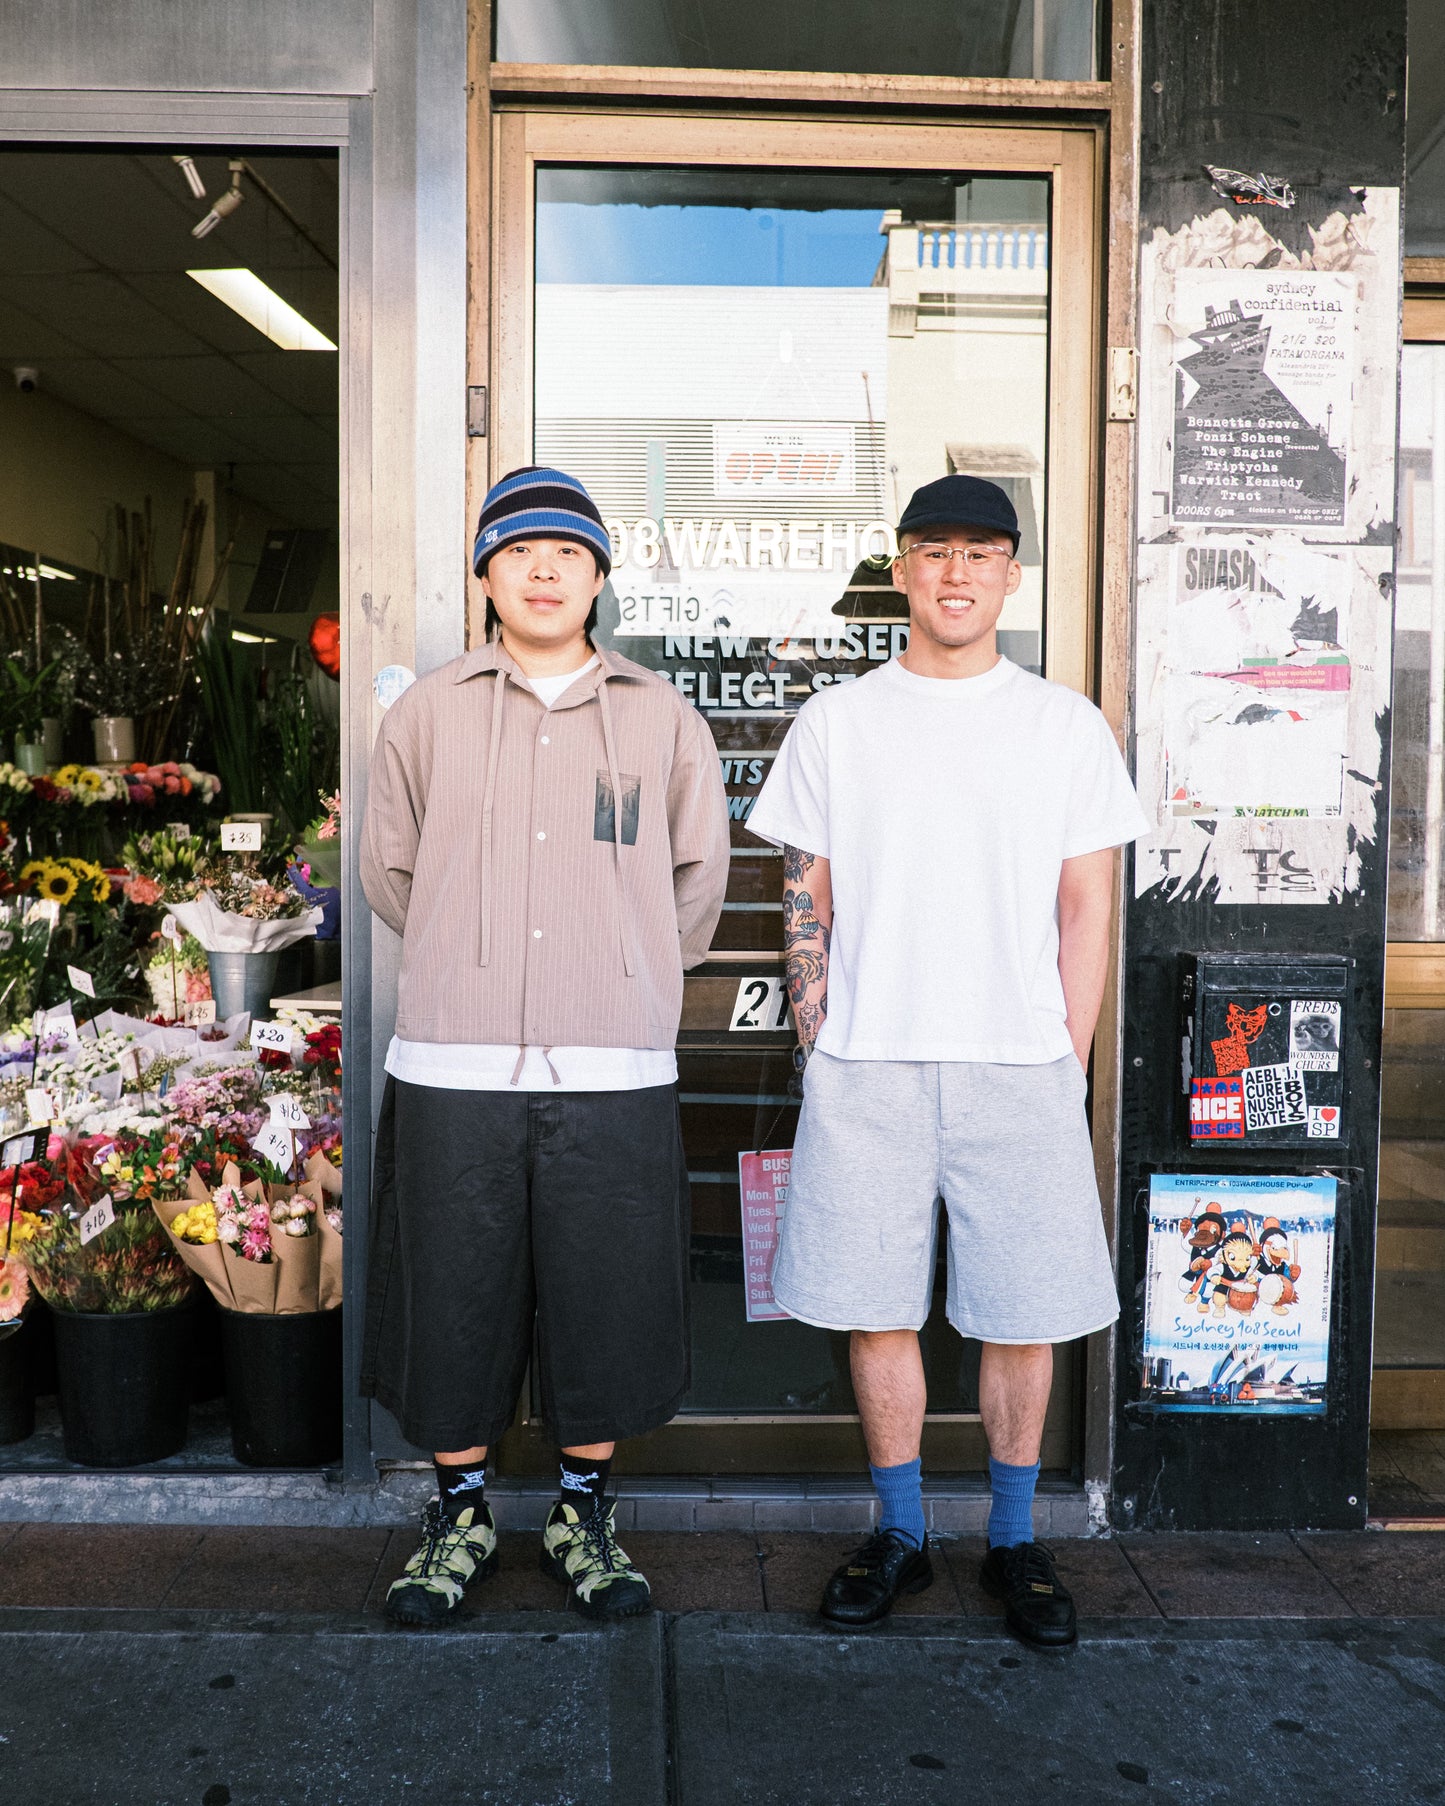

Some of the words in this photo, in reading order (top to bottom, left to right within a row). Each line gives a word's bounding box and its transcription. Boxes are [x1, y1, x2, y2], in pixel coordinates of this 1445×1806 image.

[1266, 281, 1316, 297] sydney
[1244, 298, 1343, 312] confidential
[1281, 334, 1307, 345] 21/2
[1315, 335, 1336, 345] $20
[1270, 348, 1345, 360] FATAMORGANA
[1187, 417, 1252, 429] Bennetts
[1258, 418, 1299, 429] Grove
[1195, 431, 1235, 443] Ponzi
[1241, 432, 1291, 443] Scheme
[1201, 446, 1226, 457] The
[1232, 446, 1283, 460] Engine
[1205, 461, 1279, 474] Triptychs
[1179, 475, 1239, 487] Warwick
[1245, 476, 1303, 489] Kennedy
[1220, 490, 1261, 501] Tract
[1175, 506, 1211, 516] DOORS
[1214, 507, 1235, 518] 6pm
[1185, 548, 1256, 592] SMASH
[815, 624, 911, 660] USED
[656, 670, 791, 708] ELECT
[229, 833, 252, 845] $35
[257, 1028, 286, 1046] $20
[1245, 1068, 1282, 1085] AEBL
[1246, 1081, 1284, 1099] CURE
[1248, 1095, 1285, 1113] NUSH
[280, 1102, 301, 1122] $18
[1250, 1110, 1287, 1128] SIXTE
[1311, 1123, 1336, 1137] SP
[269, 1132, 289, 1157] $15
[746, 1190, 772, 1200] Mon.
[747, 1206, 774, 1217] Tues.
[84, 1210, 106, 1233] $18
[747, 1223, 774, 1233] Wed.
[748, 1239, 775, 1250] Thur.
[749, 1256, 766, 1267] Fri.
[750, 1272, 771, 1283] Sat.
[750, 1289, 774, 1300] Sun.
[1174, 1316, 1235, 1338] Sydney
[1237, 1319, 1260, 1337] 108
[1262, 1321, 1301, 1338] Seoul
